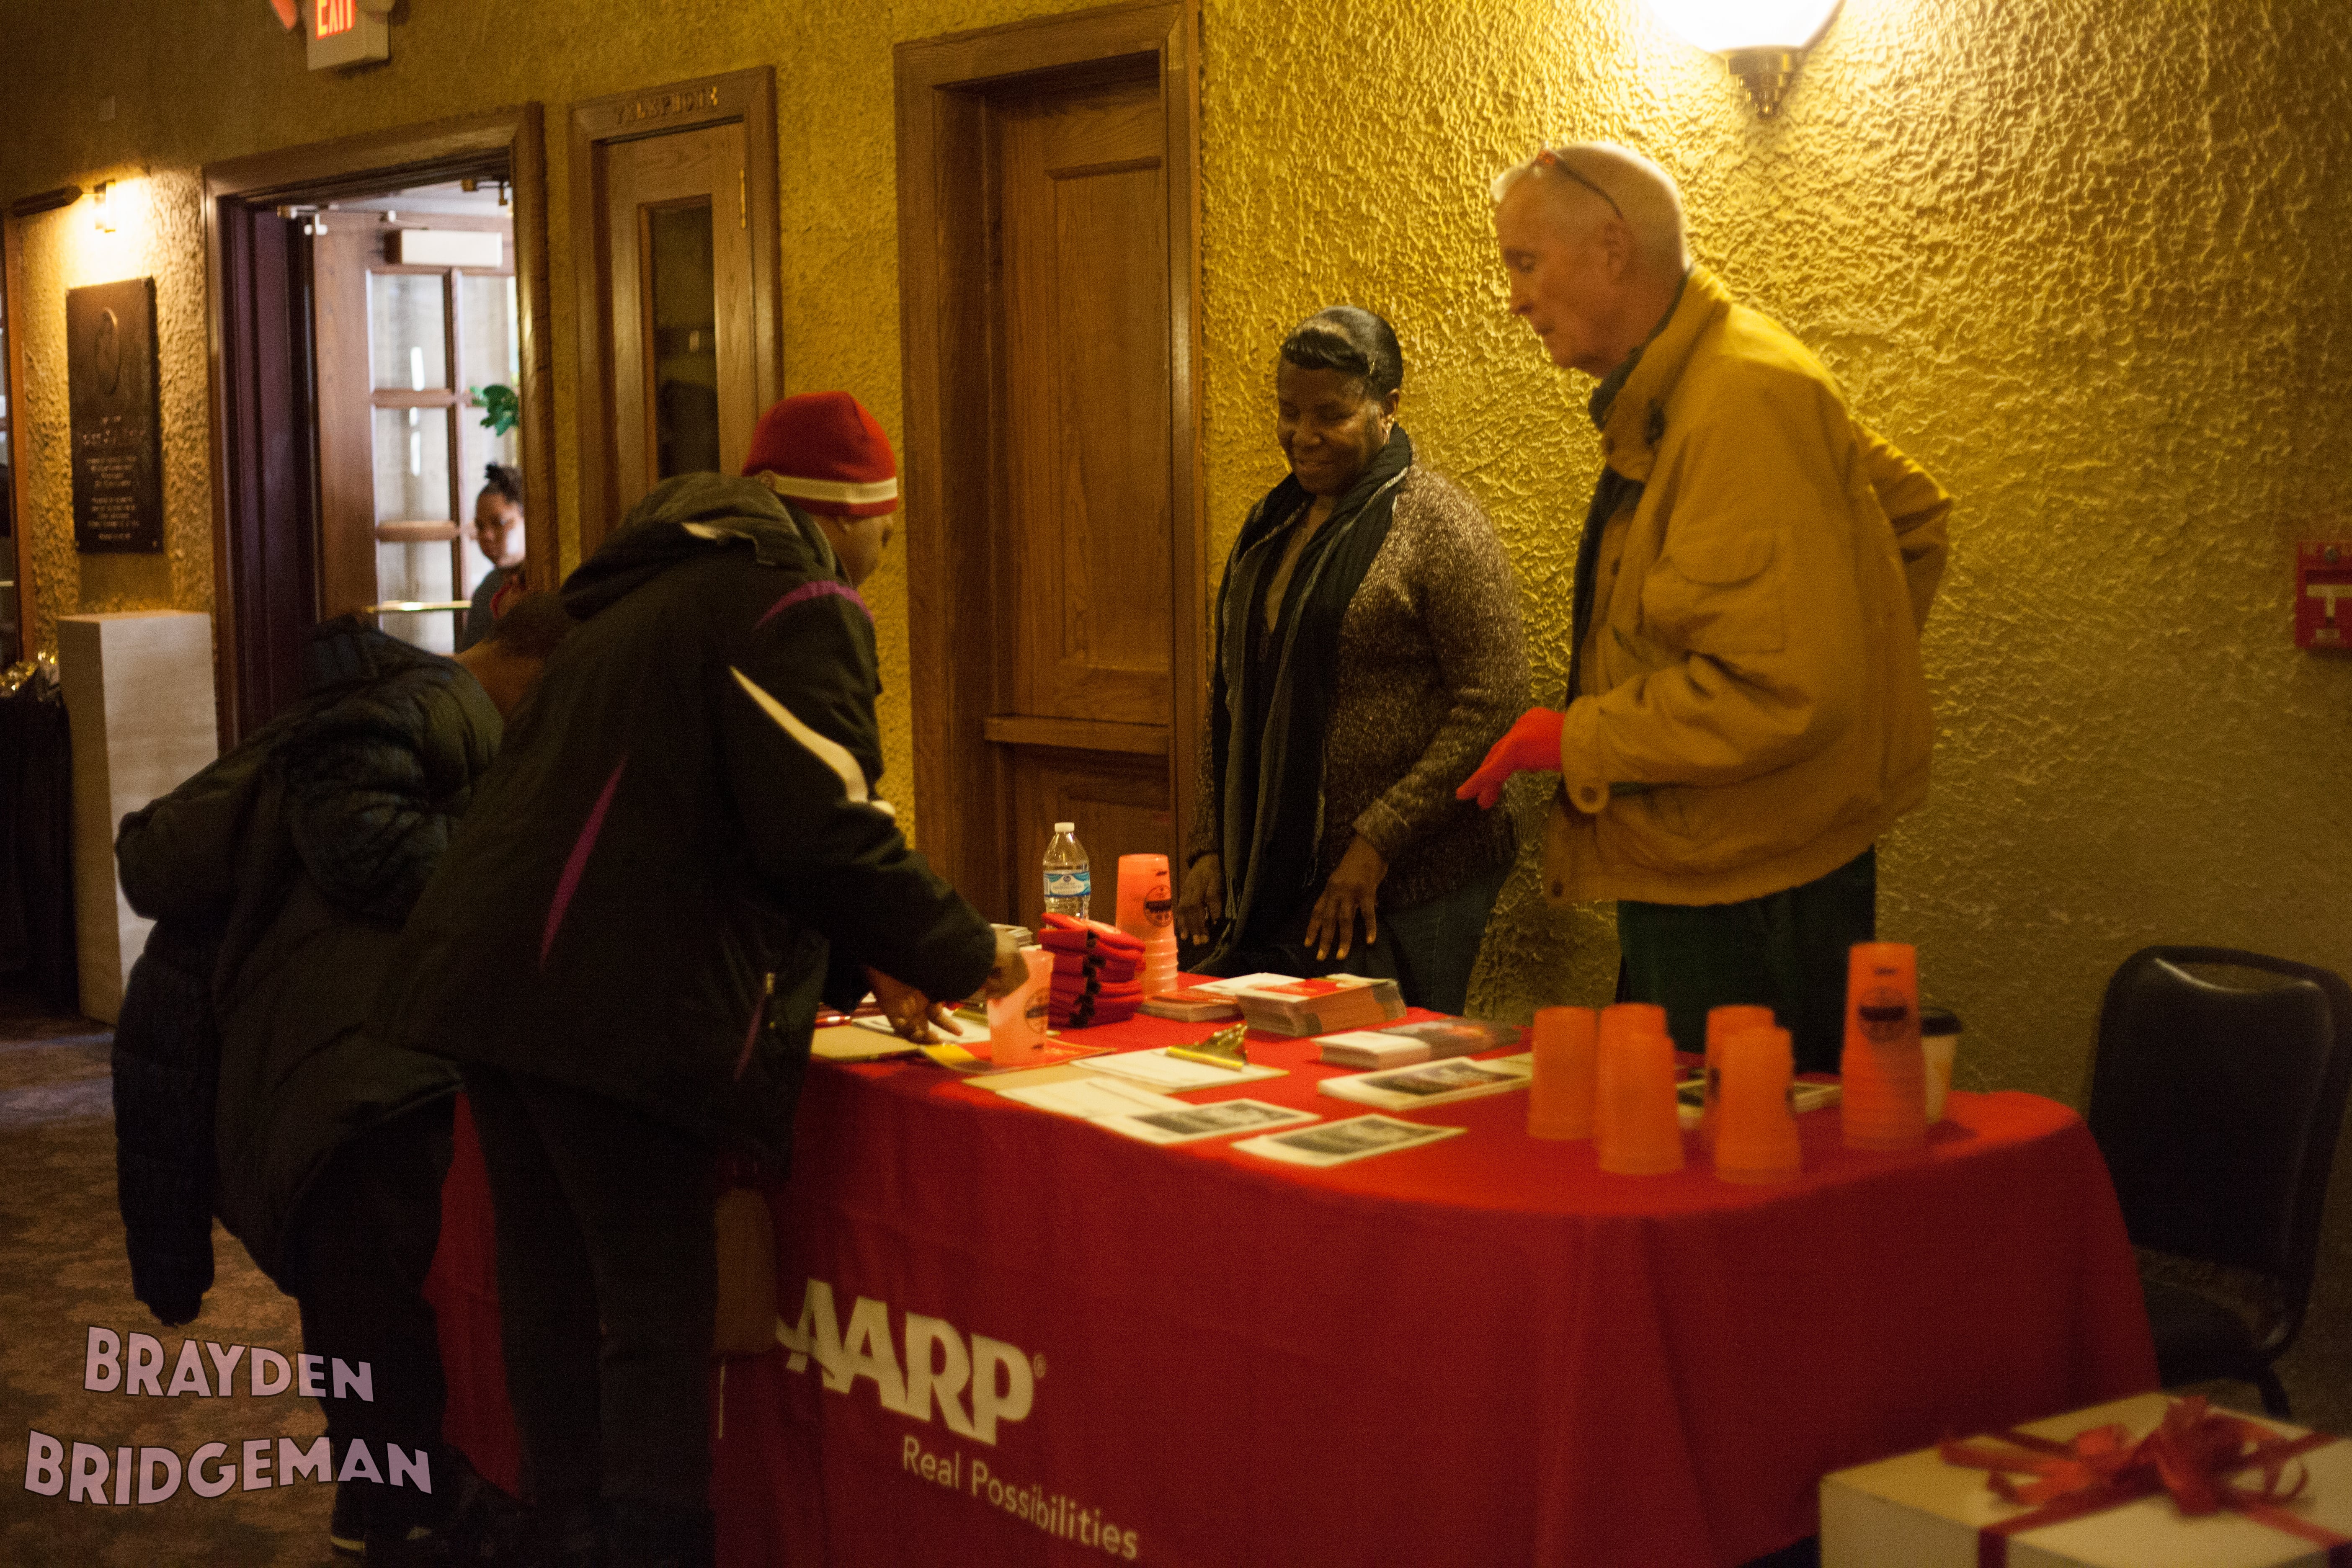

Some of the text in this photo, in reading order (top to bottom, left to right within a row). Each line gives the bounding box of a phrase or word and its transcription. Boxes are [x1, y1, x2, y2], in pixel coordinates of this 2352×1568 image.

[776, 1277, 1035, 1447] AARP
[903, 1434, 1139, 1561] Real Possibilities
